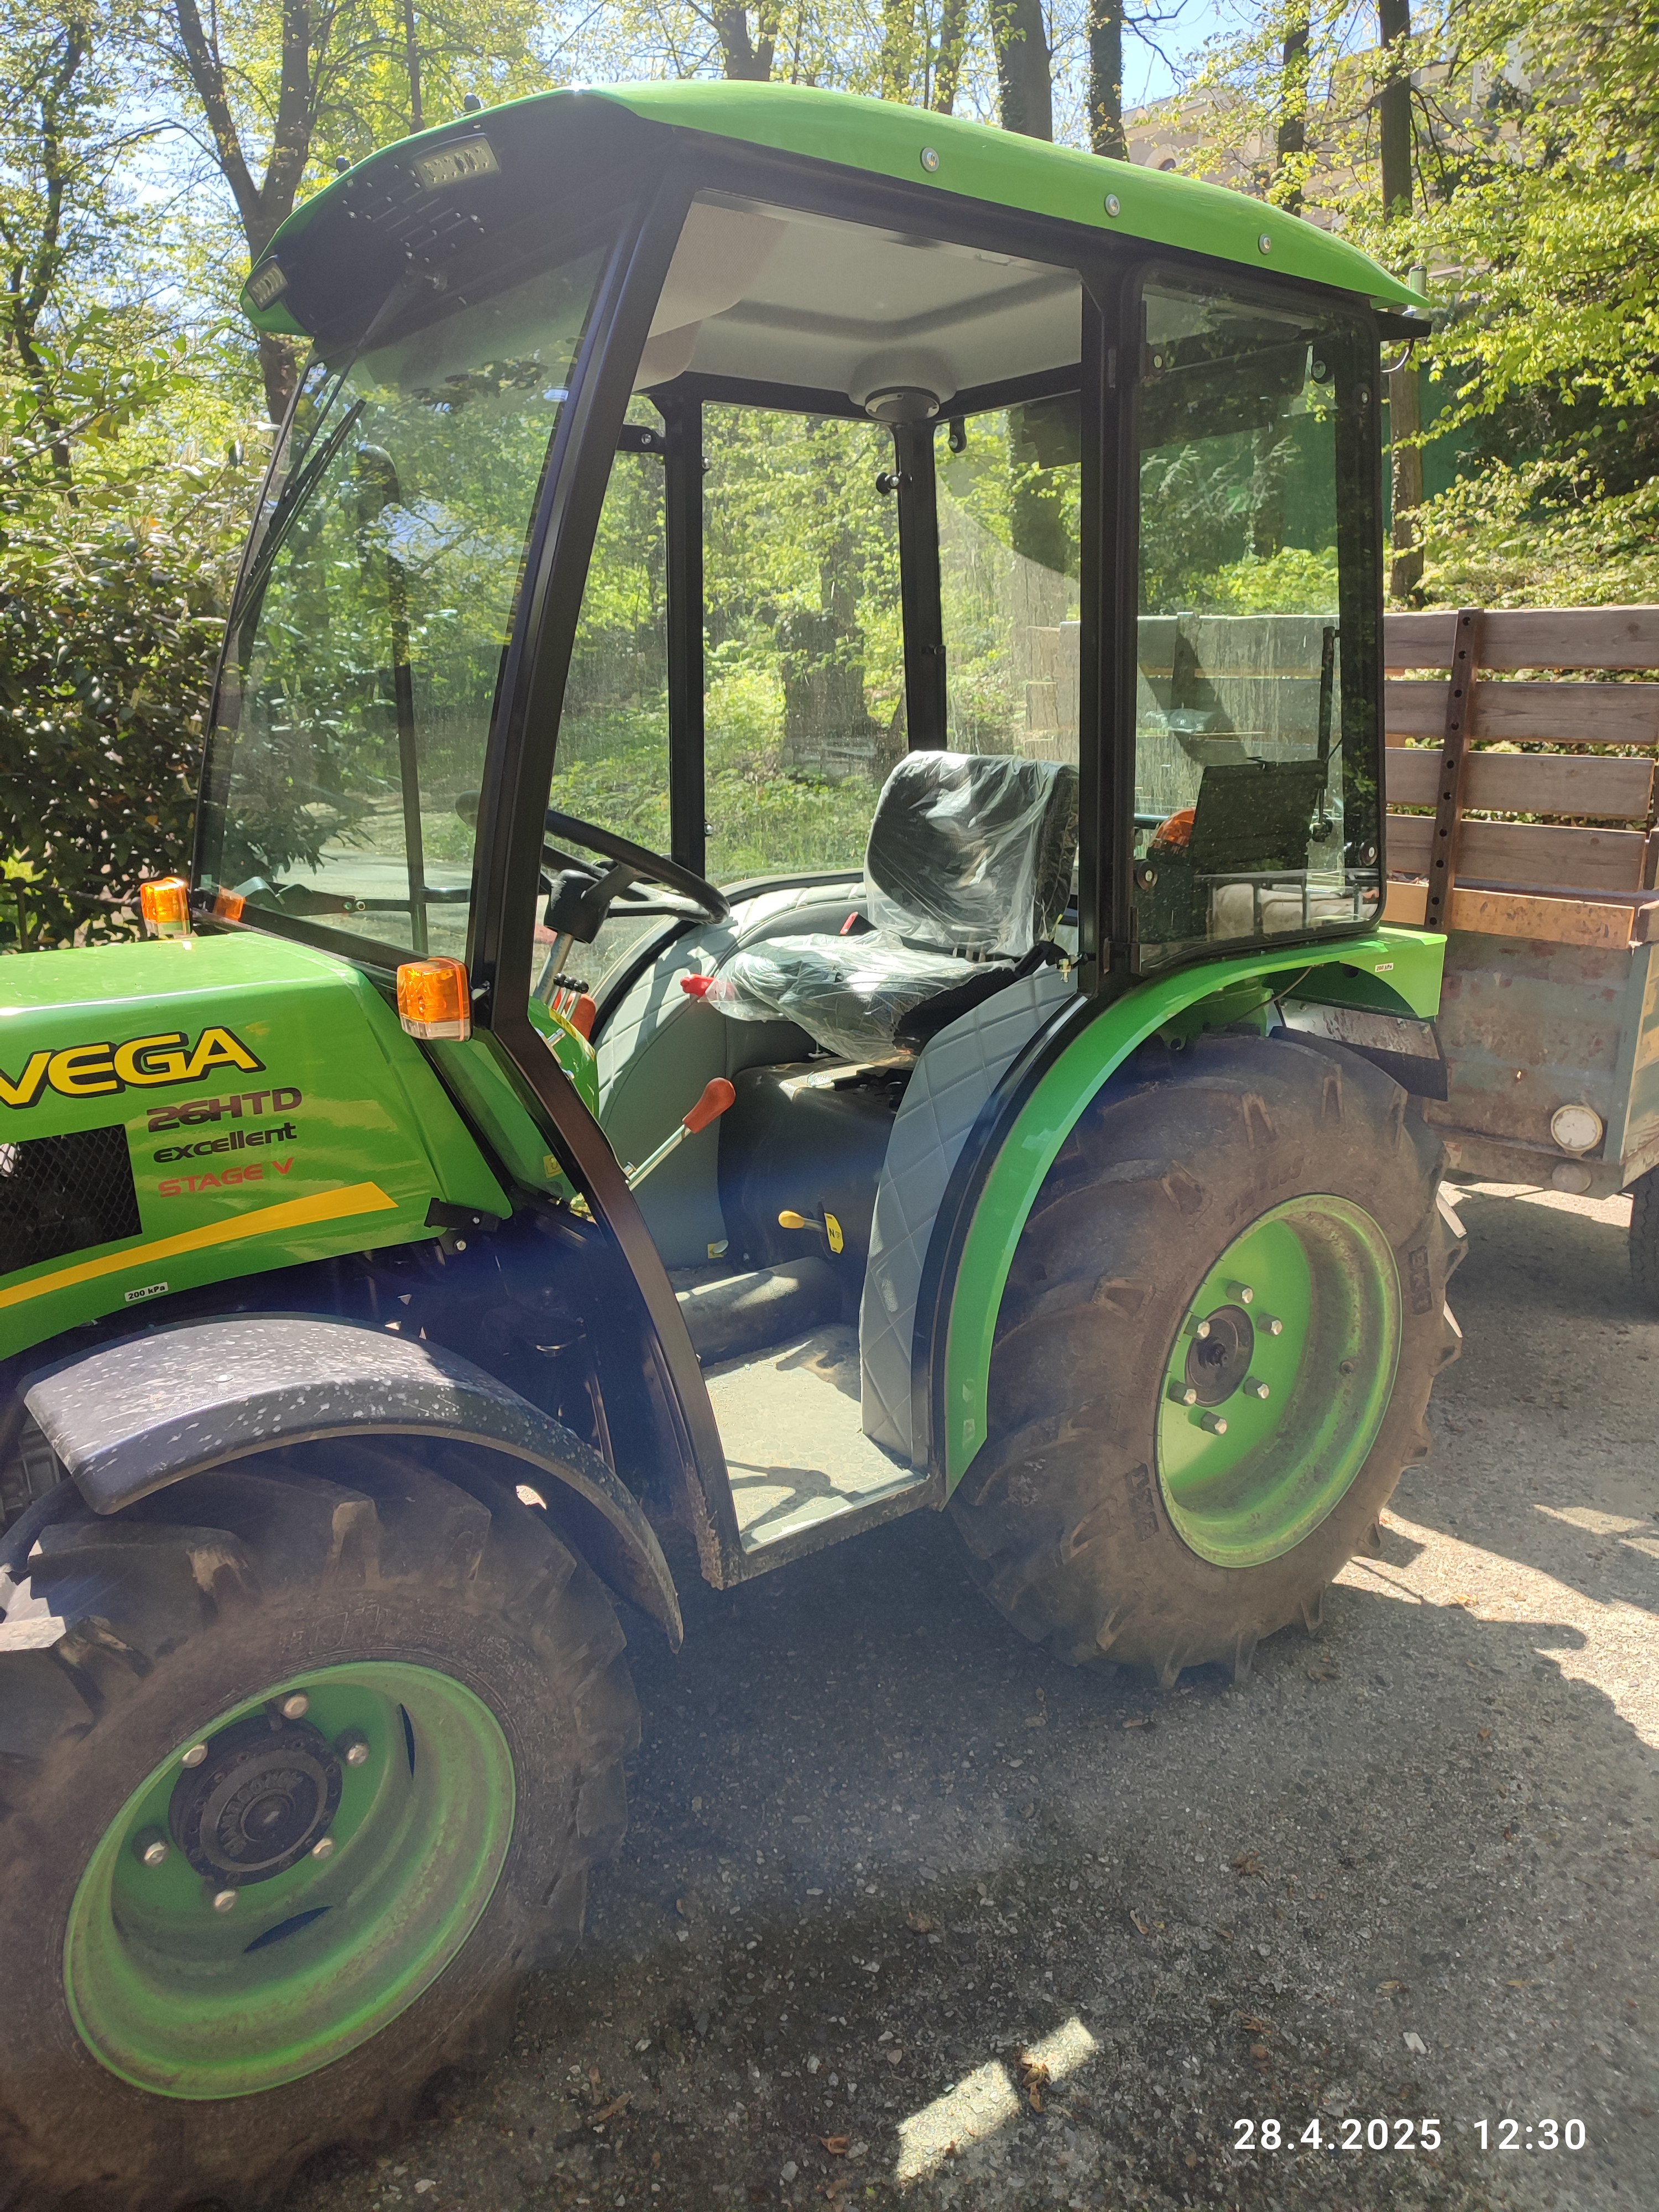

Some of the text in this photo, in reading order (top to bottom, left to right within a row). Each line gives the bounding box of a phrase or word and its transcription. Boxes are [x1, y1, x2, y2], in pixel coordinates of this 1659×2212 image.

[0, 1026, 266, 1108] VEGA
[146, 1087, 302, 1133] 26HTD
[153, 1122, 298, 1162] excellent
[158, 1157, 295, 1198] STAGE V
[829, 1227, 835, 1238] N
[128, 1285, 165, 1300] 200 kPa
